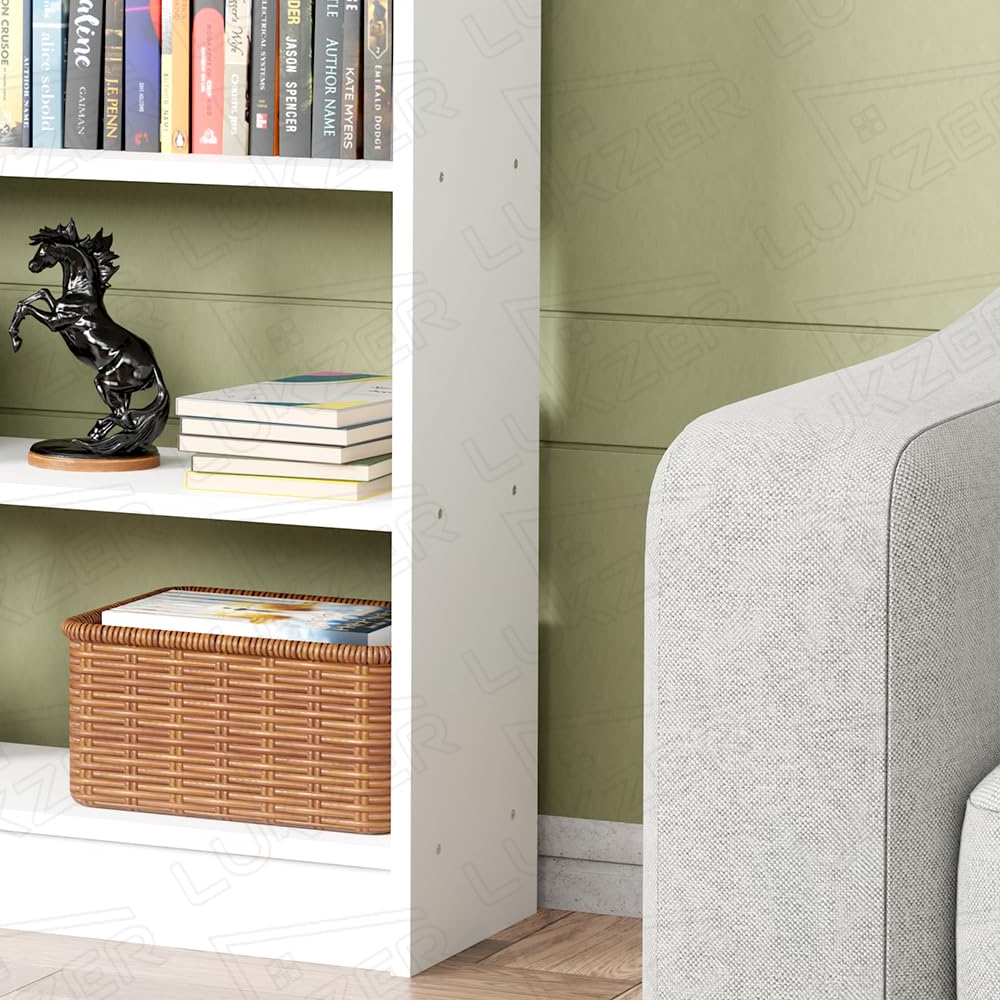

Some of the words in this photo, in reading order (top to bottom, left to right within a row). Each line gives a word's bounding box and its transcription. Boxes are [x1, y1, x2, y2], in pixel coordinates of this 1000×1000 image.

[1, 19, 9, 66] CRUSOE
[41, 33, 55, 71] alice
[230, 26, 243, 56] Wife
[285, 36, 297, 73] JASON
[325, 38, 339, 95] AUTHOR
[344, 67, 355, 101] KATE
[374, 65, 383, 110] EMERALD
[41, 76, 55, 131] sebold
[78, 86, 86, 134] GAIMAN
[106, 98, 118, 138] PENN
[285, 81, 297, 132] SPENCER
[324, 98, 336, 137] NAME
[343, 104, 354, 149] MYERS
[374, 115, 382, 150] DODGE
